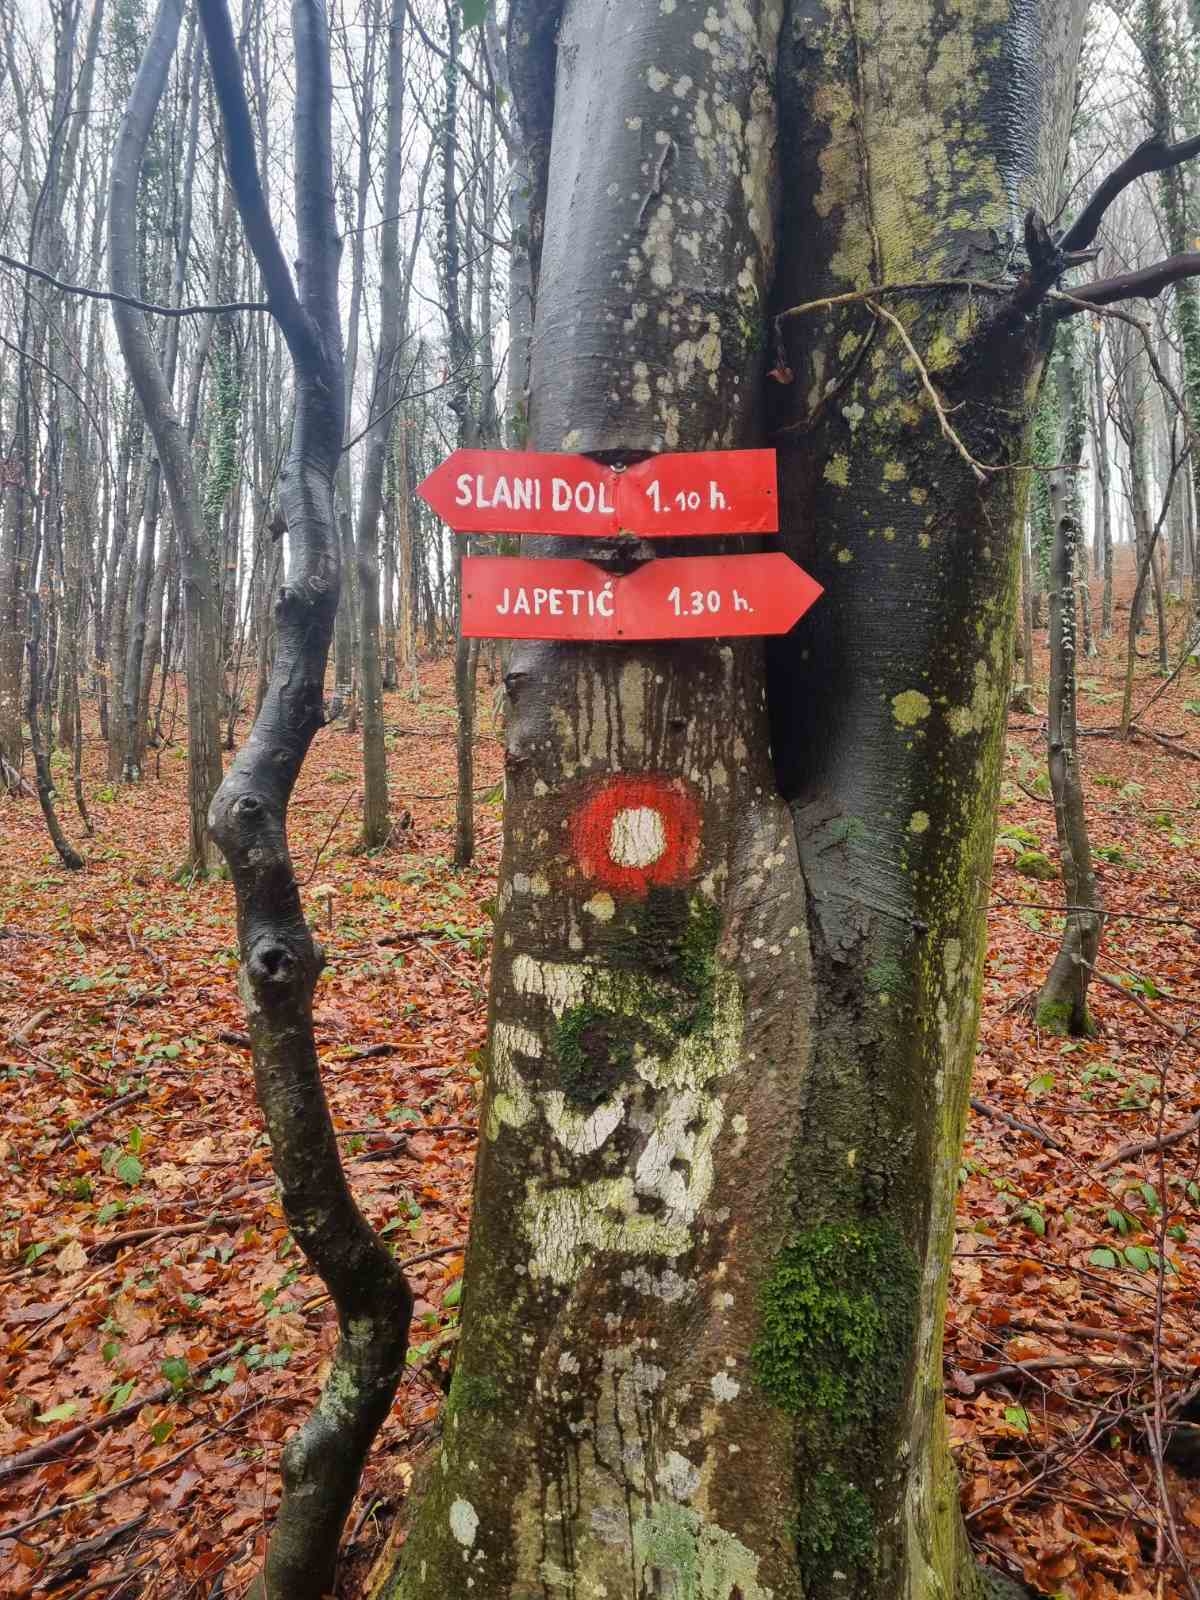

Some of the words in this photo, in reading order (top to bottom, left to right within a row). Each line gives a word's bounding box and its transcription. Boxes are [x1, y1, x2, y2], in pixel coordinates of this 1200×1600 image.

[455, 473, 541, 511] SLANI
[551, 477, 616, 514] DOL
[646, 480, 701, 512] 1.10
[709, 480, 733, 511] h.
[495, 582, 615, 617] JAPETIĆ
[667, 586, 721, 616] 1.30
[732, 589, 755, 613] h.
